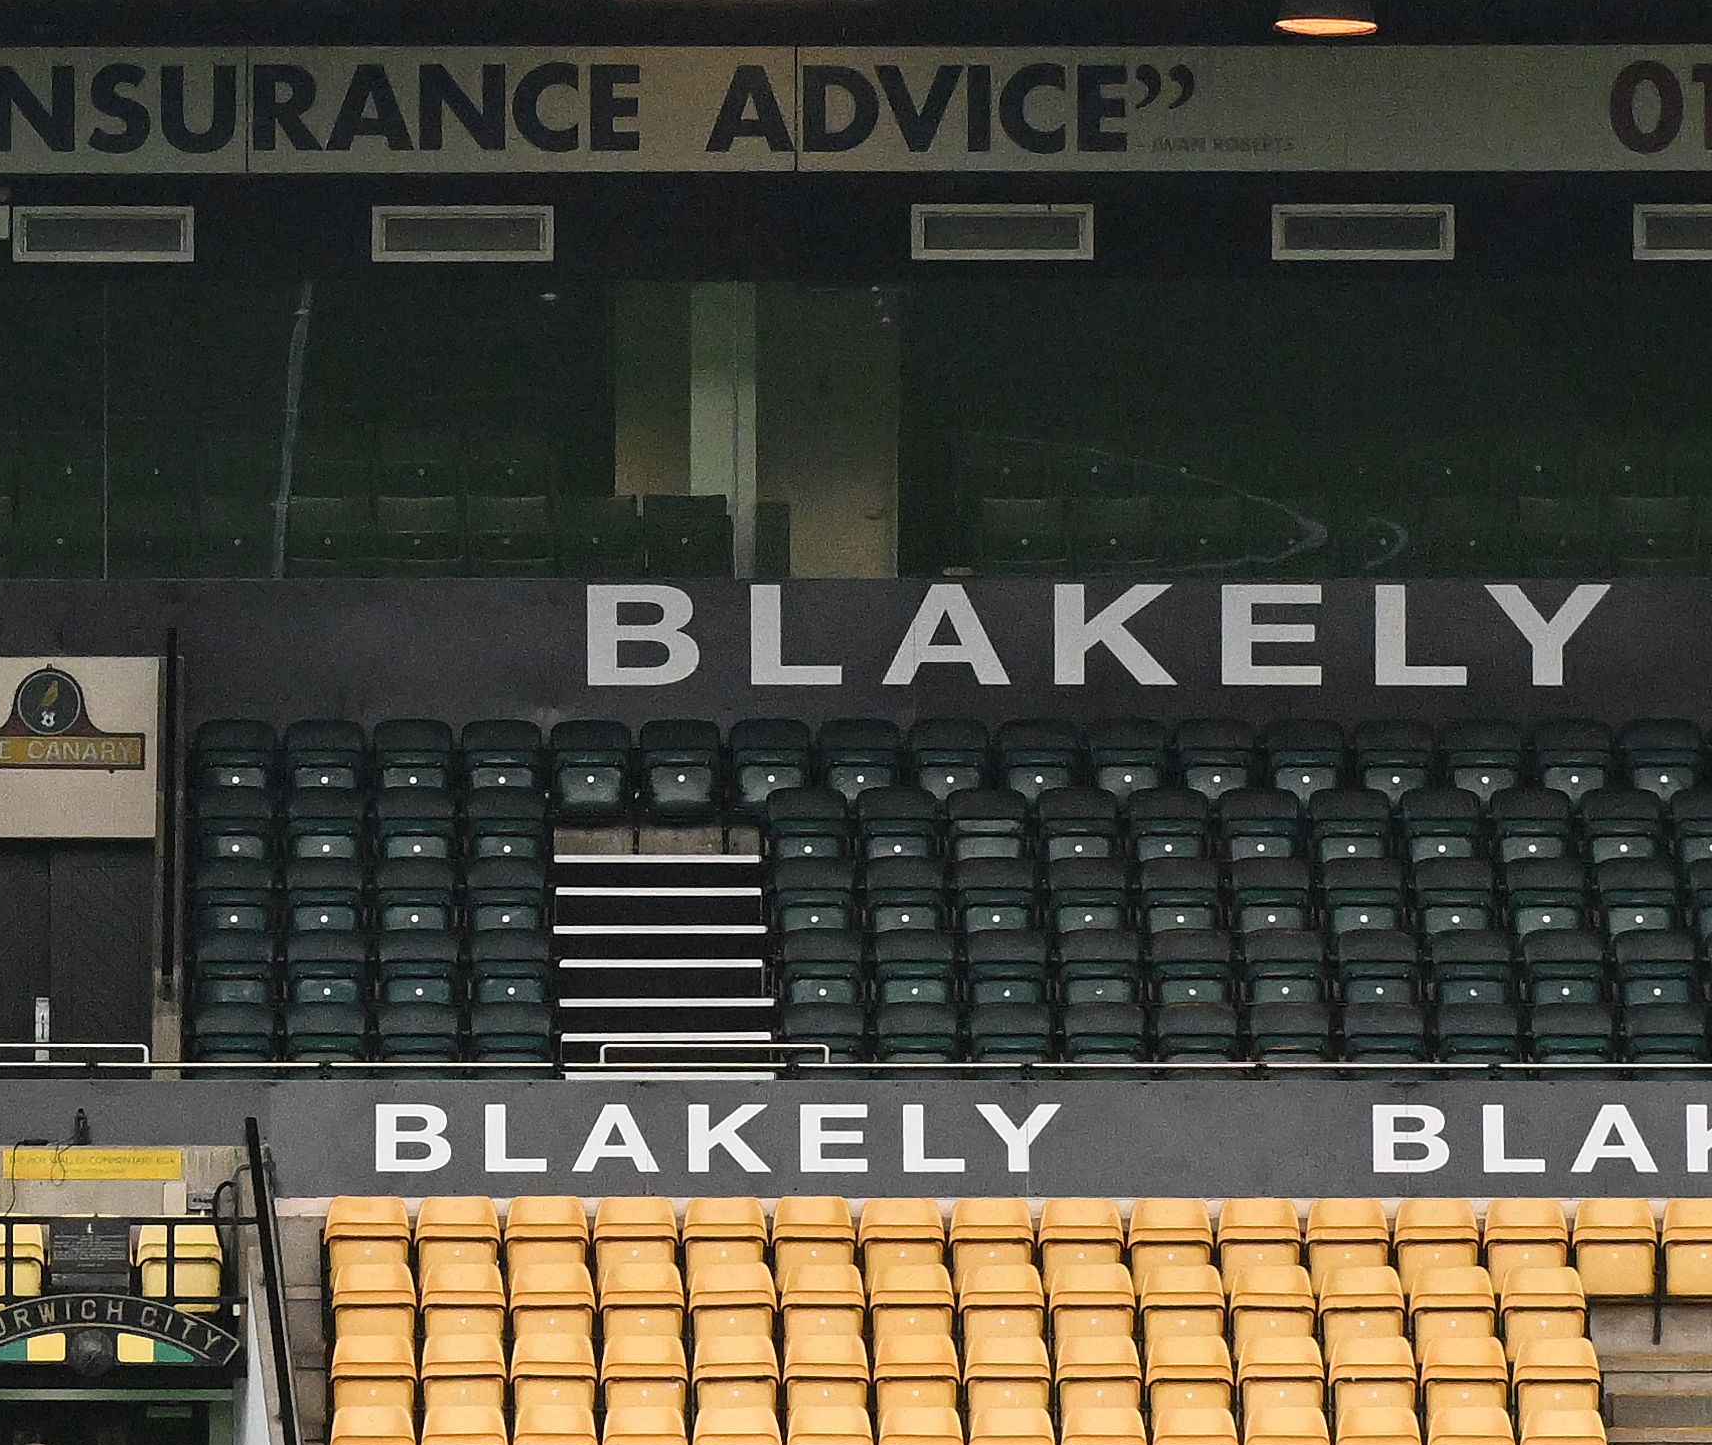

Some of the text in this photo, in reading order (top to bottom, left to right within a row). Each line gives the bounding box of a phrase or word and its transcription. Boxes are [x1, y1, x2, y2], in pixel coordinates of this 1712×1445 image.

[586, 583, 1611, 687] BLAKELY
[27, 739, 135, 761] CANARY
[375, 1103, 1061, 1174] BLAKELY
[139, 1306, 223, 1352] CITY
